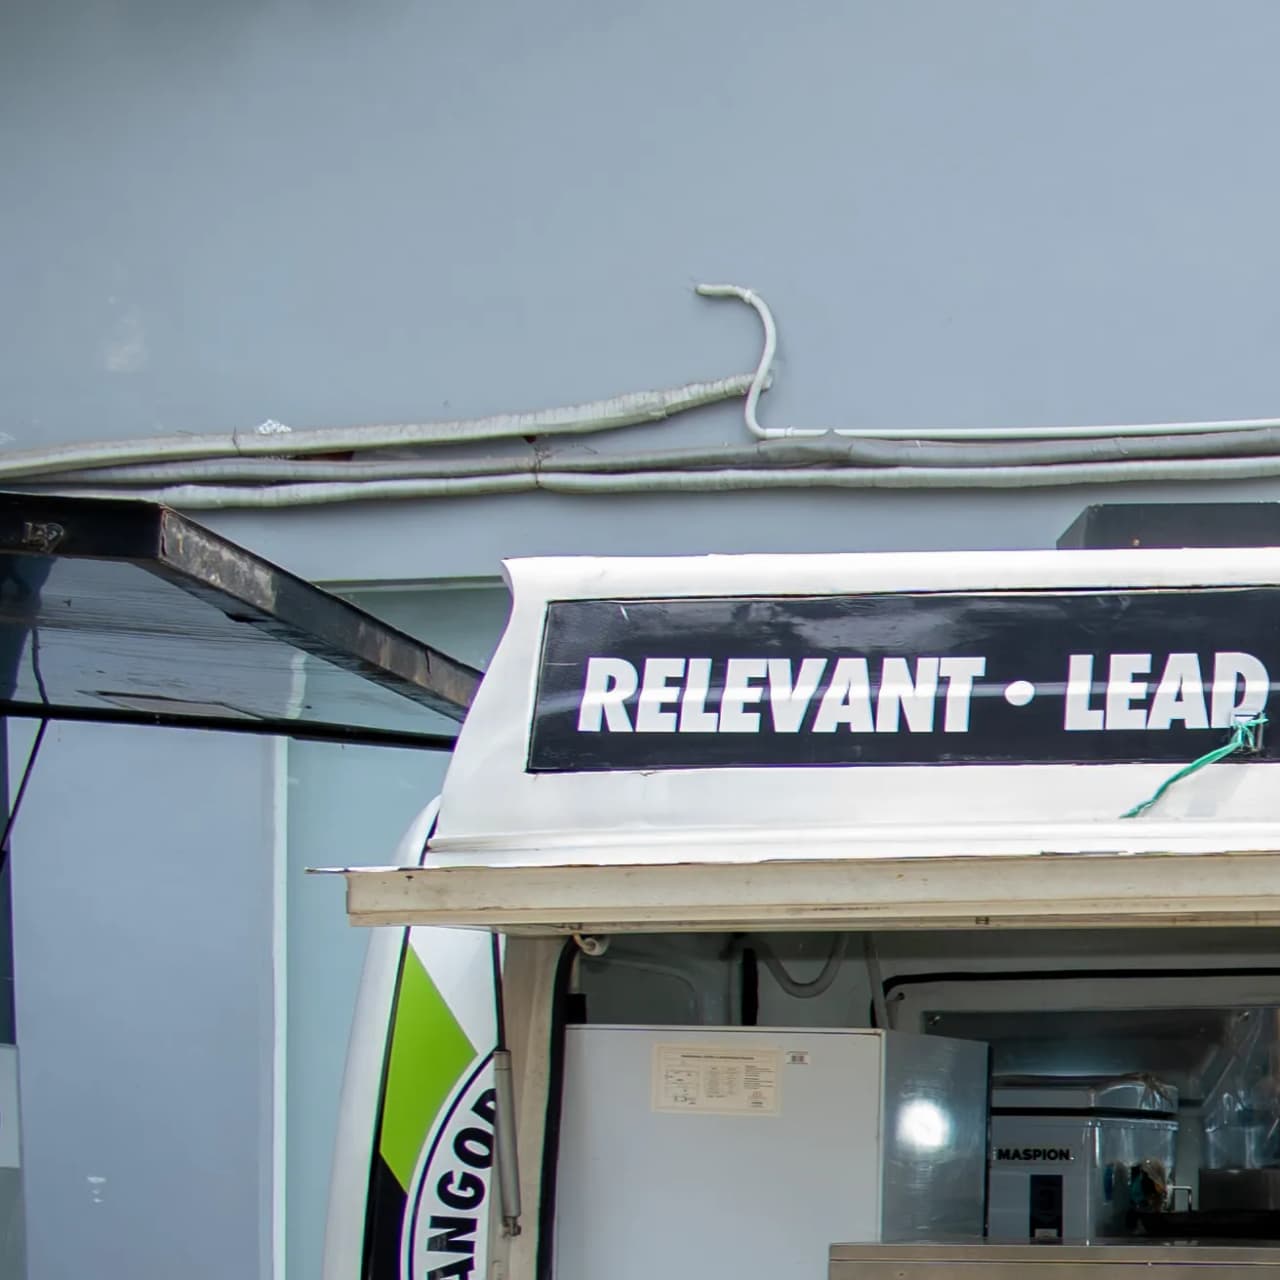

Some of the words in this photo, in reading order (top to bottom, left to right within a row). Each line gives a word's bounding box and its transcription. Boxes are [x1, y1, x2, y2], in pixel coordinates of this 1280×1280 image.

[578, 656, 986, 733] RELEVANT
[1064, 651, 1269, 732] LEAD
[997, 1148, 1070, 1160] MASPION
